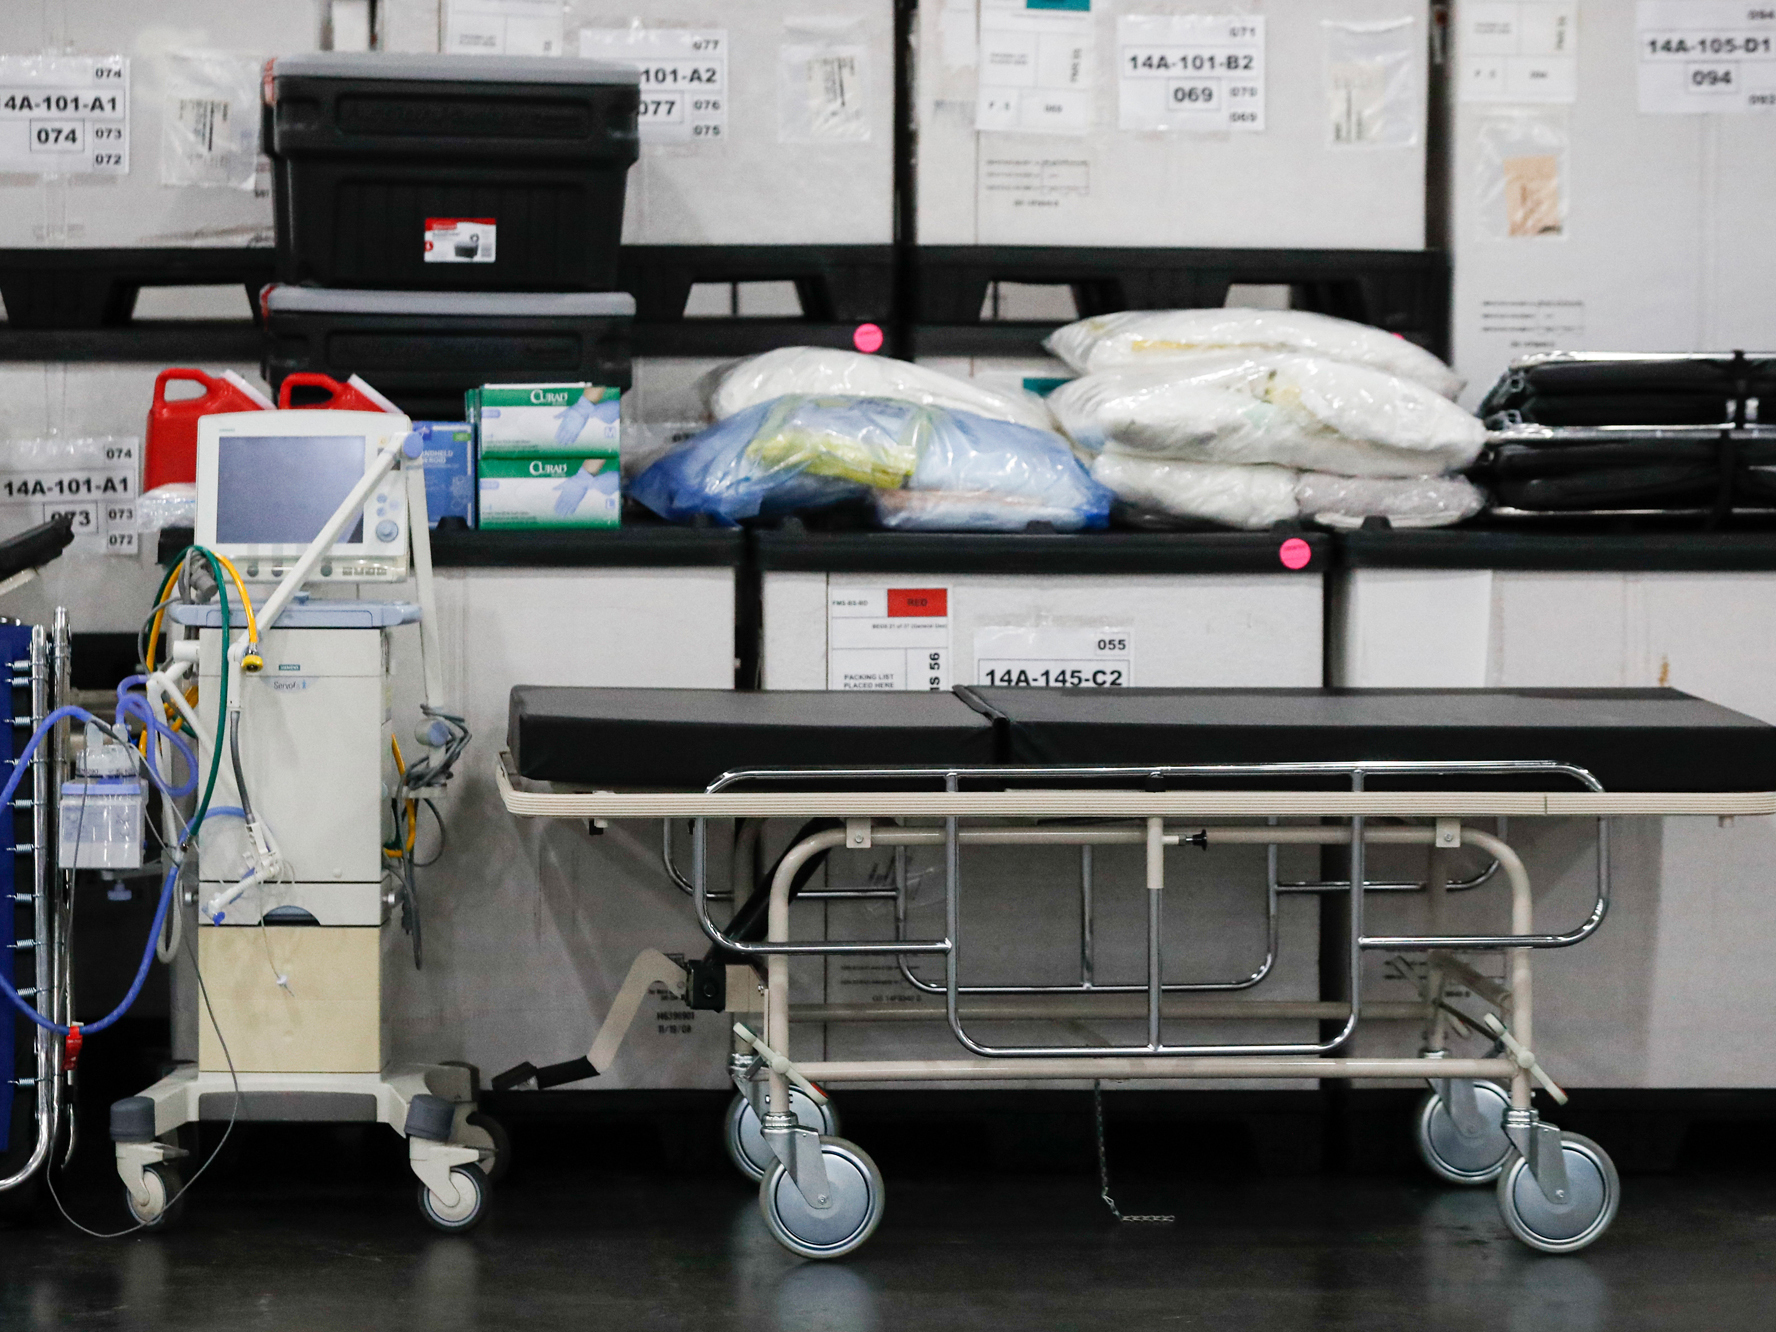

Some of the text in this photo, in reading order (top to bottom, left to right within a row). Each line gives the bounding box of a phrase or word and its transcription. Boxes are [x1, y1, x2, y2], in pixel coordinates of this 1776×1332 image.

[1648, 38, 1770, 53] 14A-105-D1
[1129, 54, 1254, 70] 14A-101-B2
[95, 68, 122, 79] 074
[1692, 71, 1731, 86] 094
[1174, 87, 1213, 102] 069
[36, 128, 77, 144] 074
[95, 128, 121, 139] 073
[95, 154, 121, 165] 072
[530, 389, 568, 404] CURAD
[106, 448, 132, 459] 074
[529, 461, 567, 476] CURAD
[4, 477, 128, 497] 14A-101-A1
[108, 508, 133, 520] 073
[109, 534, 133, 546] 072
[1098, 639, 1126, 650] 055
[929, 652, 941, 671] 56
[986, 669, 1123, 687] 14A-145-C2
